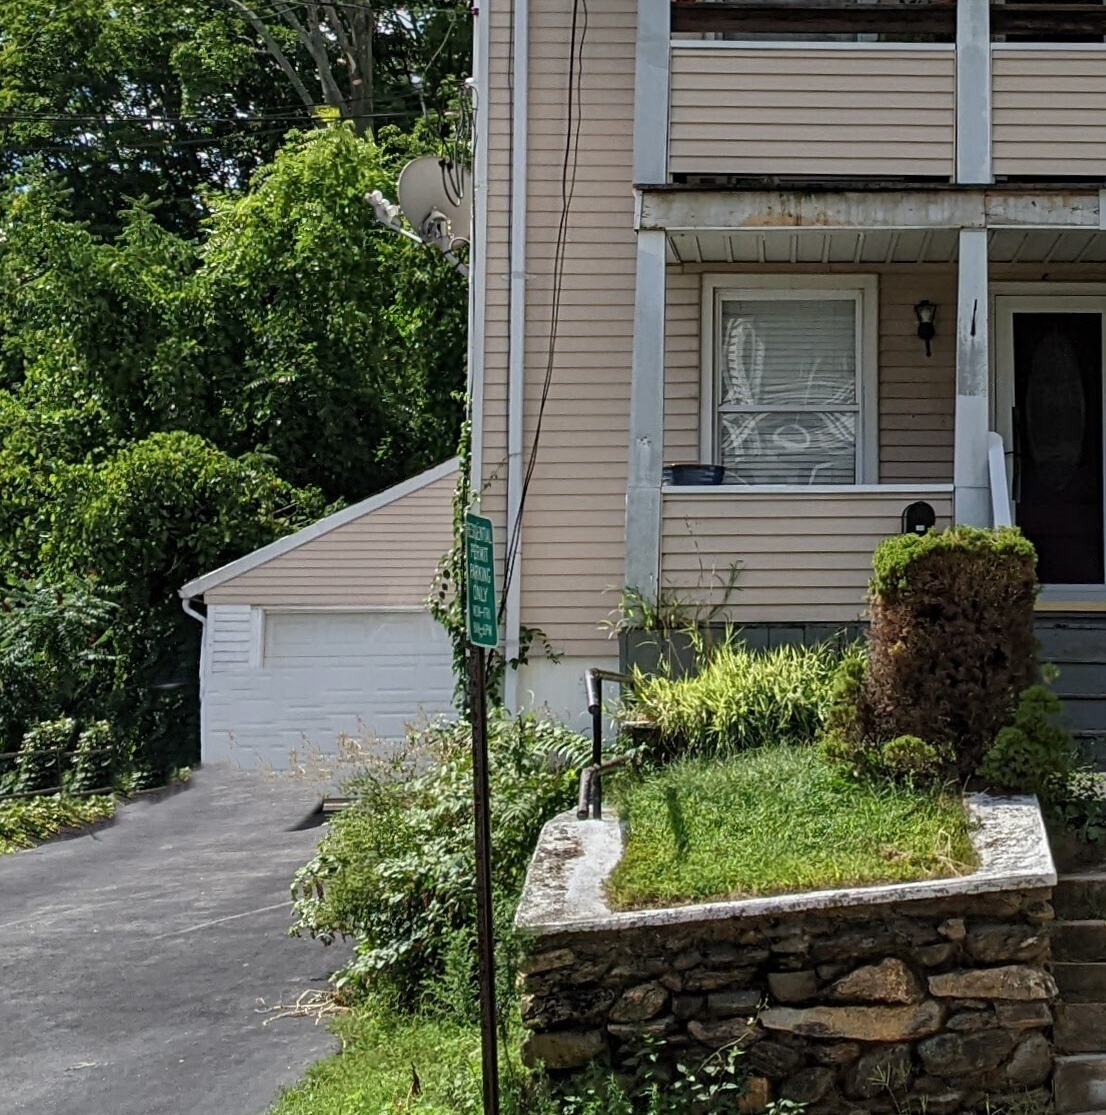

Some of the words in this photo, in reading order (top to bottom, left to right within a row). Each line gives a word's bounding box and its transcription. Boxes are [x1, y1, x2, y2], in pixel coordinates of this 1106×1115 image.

[470, 543, 489, 562] PERMIT
[470, 563, 491, 584] PARKING
[472, 584, 488, 602] ONLY
